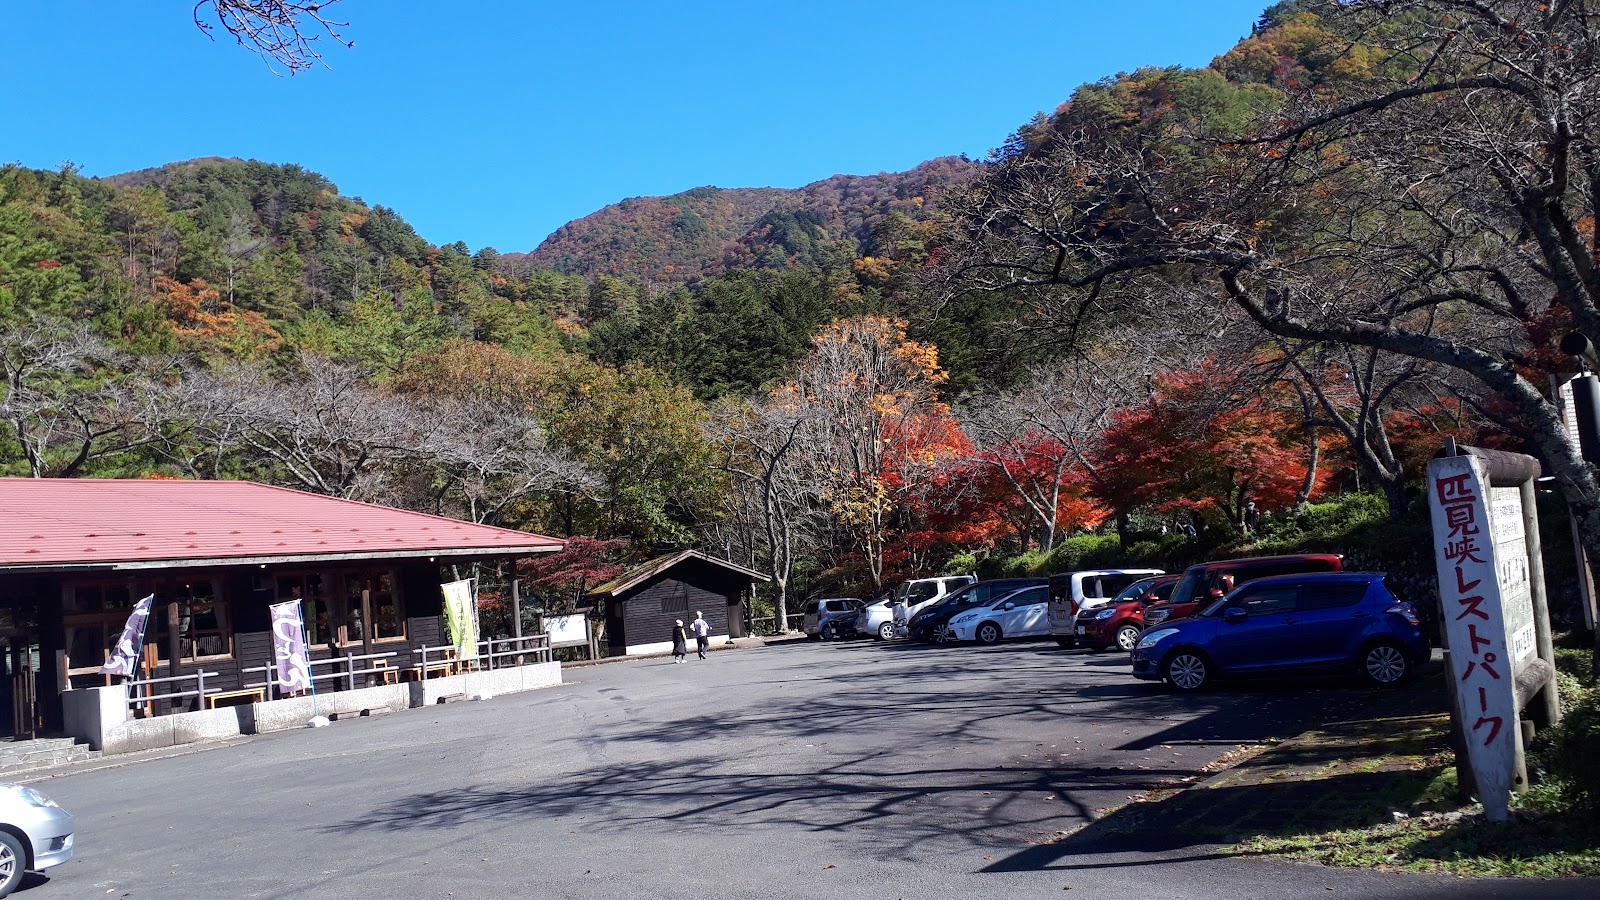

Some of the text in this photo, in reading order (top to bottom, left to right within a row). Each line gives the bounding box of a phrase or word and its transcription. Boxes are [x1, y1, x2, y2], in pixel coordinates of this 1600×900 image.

[1435, 473, 1503, 746] 匹見峡レストパーク
